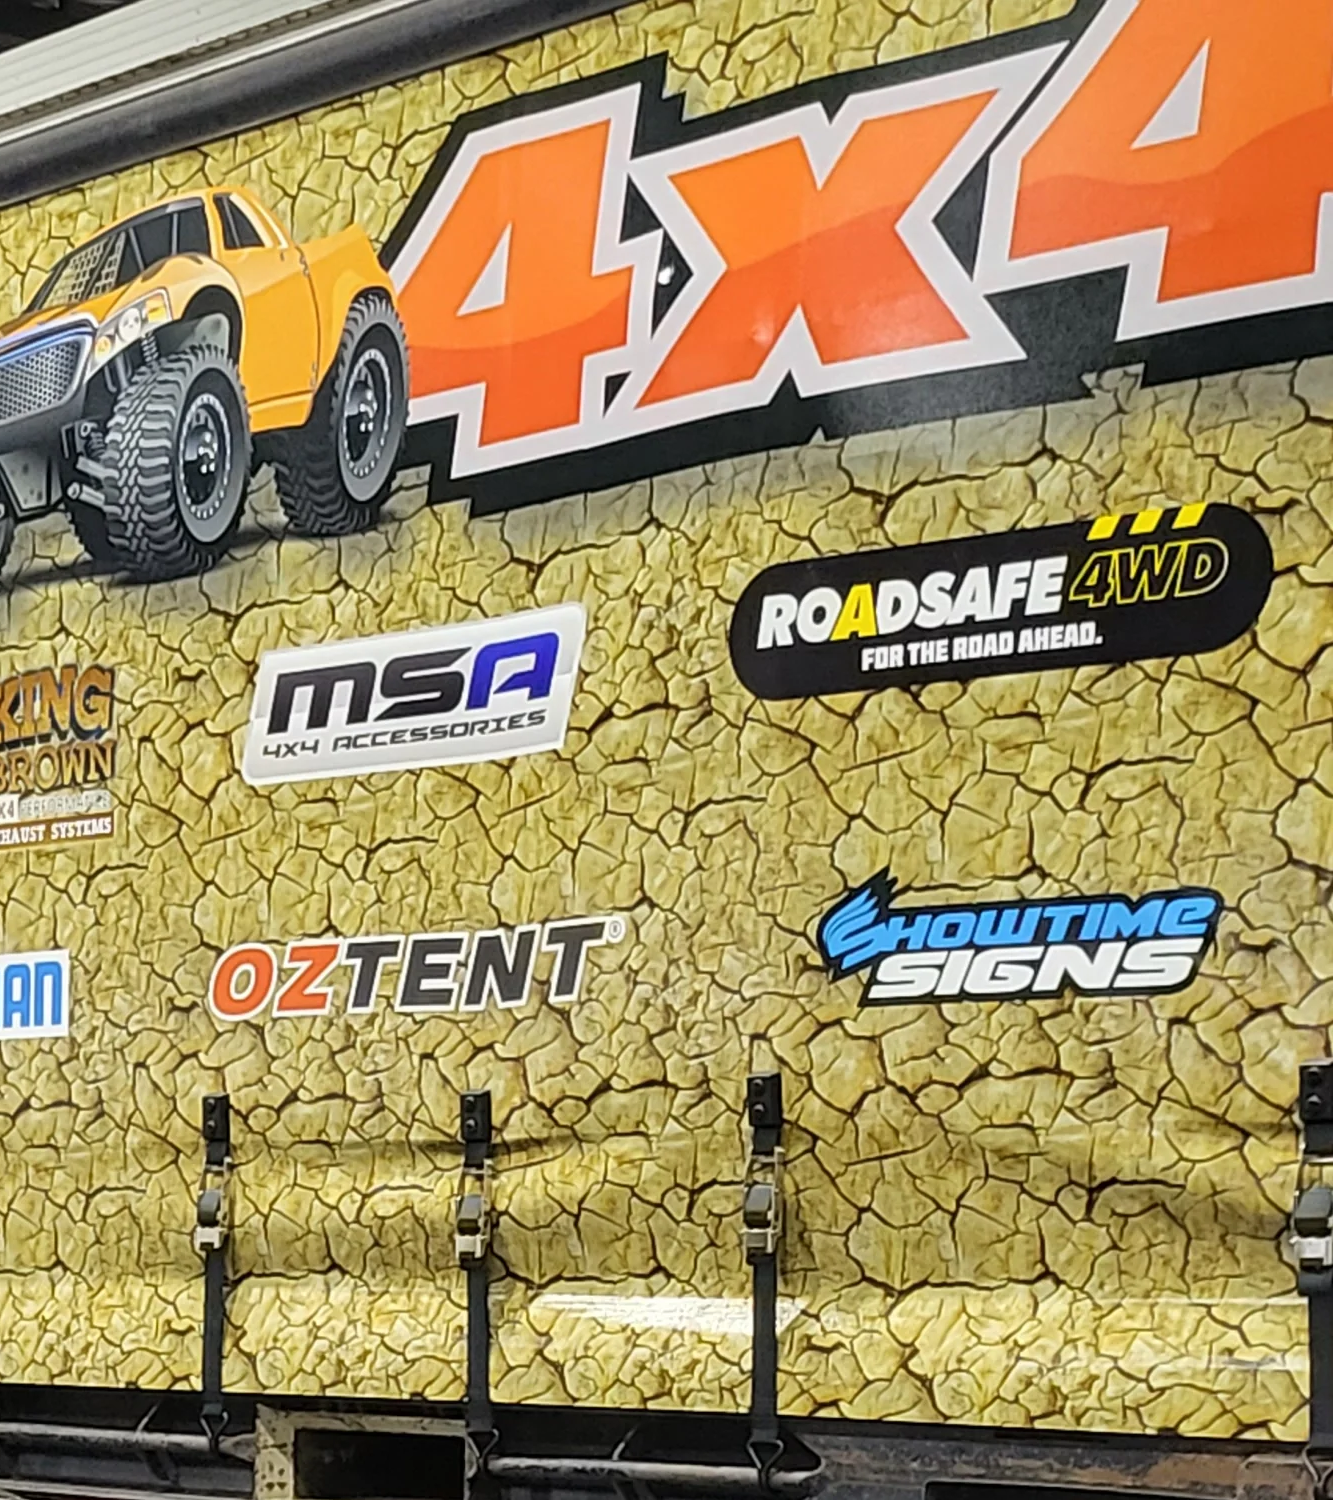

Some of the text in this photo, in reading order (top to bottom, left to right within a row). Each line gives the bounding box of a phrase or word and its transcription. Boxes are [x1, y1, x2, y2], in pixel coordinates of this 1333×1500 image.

[755, 537, 1229, 650] ROADSAFE 4WD
[861, 621, 1103, 671] FOR THE ROAD AHEAD.
[266, 632, 559, 735] MSA
[332, 709, 547, 752] ACCESSORIES
[50, 816, 112, 840] SYSTEMS
[822, 888, 1217, 970] SHOWTIME
[210, 920, 607, 1017] OZTENT
[868, 938, 1203, 998] SIGNS
